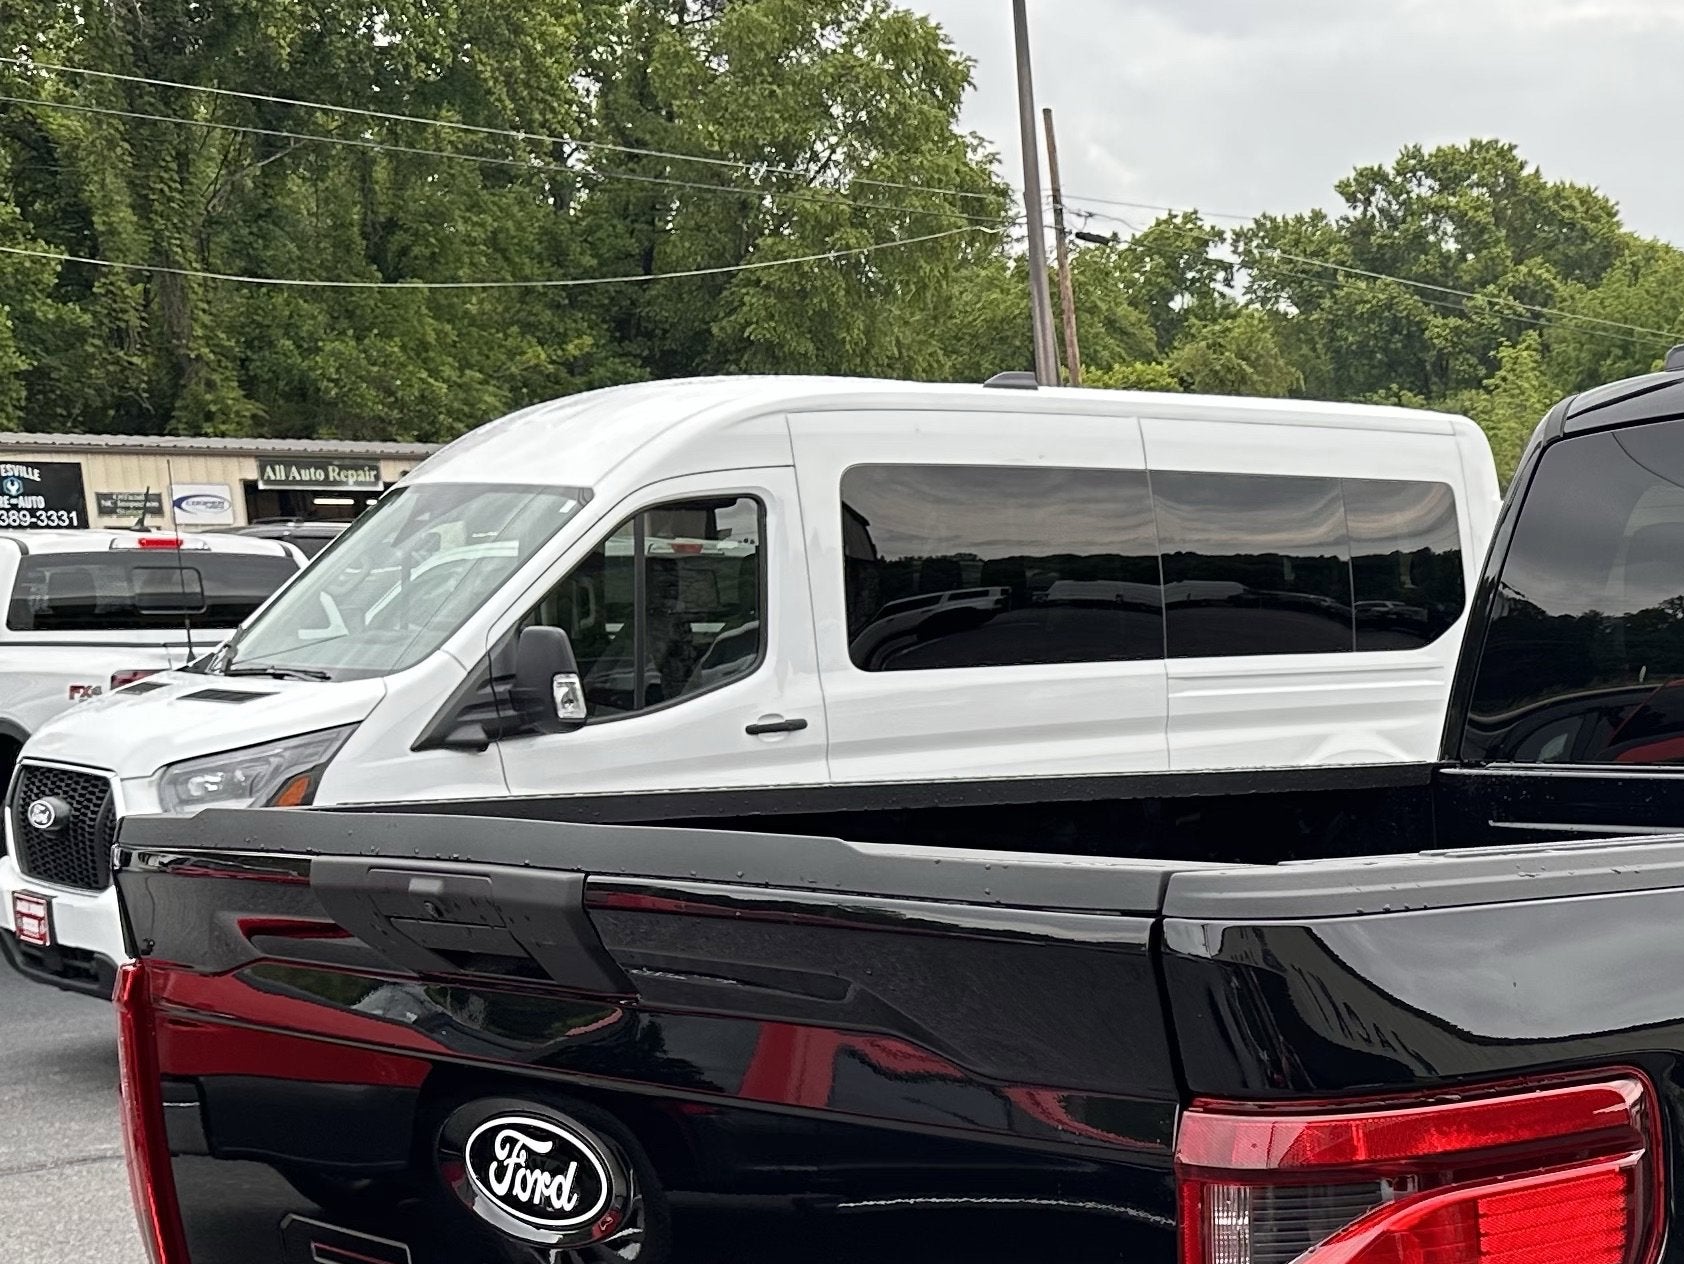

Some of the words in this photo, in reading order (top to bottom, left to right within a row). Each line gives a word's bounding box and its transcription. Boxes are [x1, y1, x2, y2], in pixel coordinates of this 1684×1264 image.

[0, 464, 41, 482] ESVILLE
[263, 464, 286, 480] All
[288, 464, 325, 481] Auto
[328, 465, 377, 486] Repair
[0, 495, 46, 509] E-AUTO
[0, 510, 78, 527] 389-3331
[488, 1129, 578, 1212] Ford
